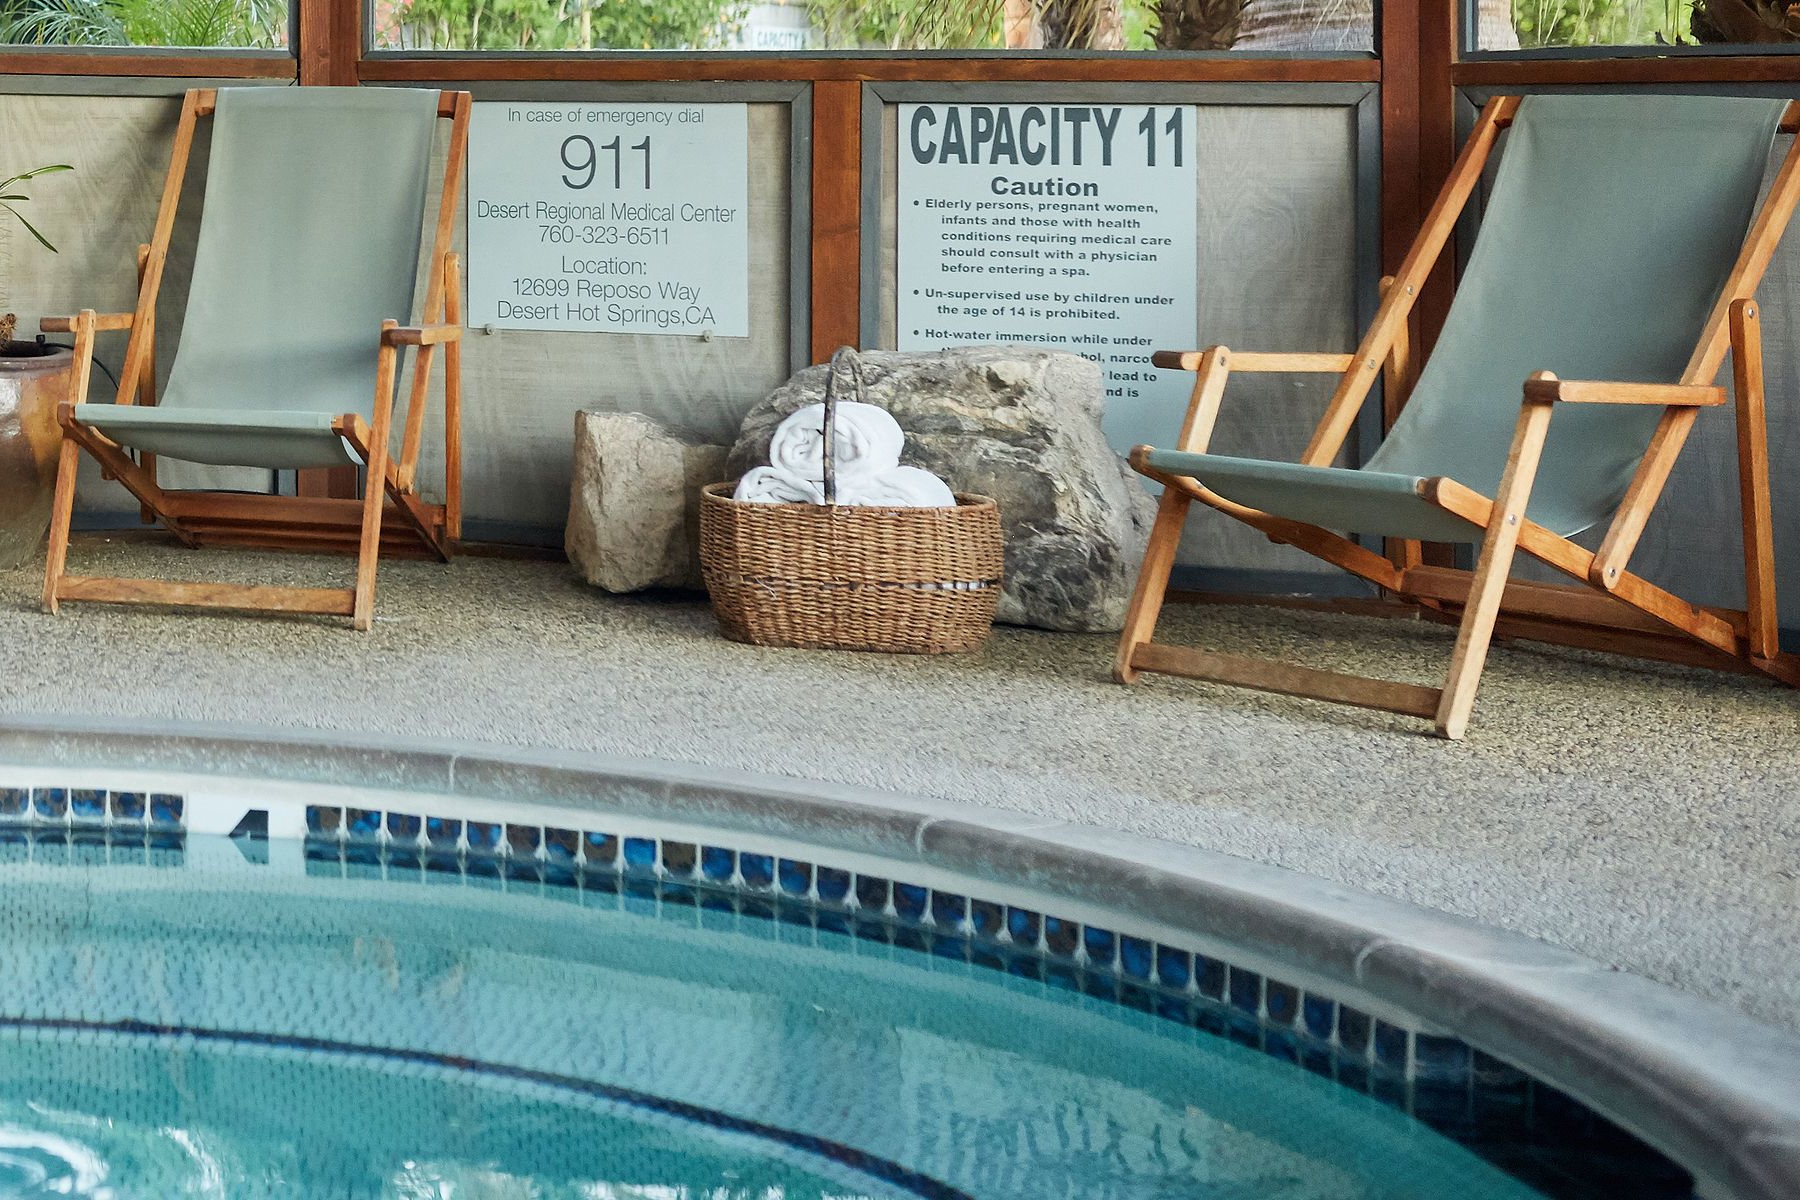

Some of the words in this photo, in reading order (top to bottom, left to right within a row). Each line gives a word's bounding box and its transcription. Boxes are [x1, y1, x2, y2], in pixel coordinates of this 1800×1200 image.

[508, 107, 521, 122] In
[526, 109, 563, 122] case
[567, 107, 582, 122] of
[586, 109, 673, 126] emergency
[677, 108, 705, 123] dial
[910, 105, 1123, 167] CAPACITY
[1138, 106, 1183, 168] 11
[560, 134, 651, 190] 911
[990, 175, 1099, 197] Caution
[477, 199, 530, 219] Desert
[535, 200, 605, 224] Regional
[611, 202, 675, 222] Medical
[680, 203, 737, 223] Center
[925, 198, 972, 212] Elderly
[975, 200, 1035, 213] persons,
[1038, 202, 1100, 214] pregnant
[1104, 203, 1160, 214] women,
[941, 214, 988, 226] infants
[991, 216, 1016, 226] and
[1020, 216, 1059, 227] those
[1063, 217, 1093, 228] with
[1097, 218, 1141, 229] health
[538, 224, 669, 245] 760-323-6511
[941, 231, 1012, 243] conditions
[1015, 232, 1077, 246] requiring
[1081, 234, 1136, 245] medical
[1140, 236, 1173, 246] care
[941, 247, 986, 258] should
[989, 248, 1040, 259] consult
[1043, 249, 1074, 260] with
[1078, 252, 1087, 260] a
[1091, 250, 1158, 263] physician
[562, 255, 647, 276] Location:
[941, 263, 985, 274] before
[988, 265, 1045, 277] entering
[1048, 266, 1057, 276] a
[1061, 267, 1090, 278] spa.
[512, 278, 570, 297] 12699
[577, 279, 652, 302] Reposo
[657, 281, 701, 305] Way
[925, 288, 1021, 302] Un-supervised
[1025, 291, 1050, 302] use
[1053, 291, 1071, 304] by
[1074, 293, 1130, 304] children
[1134, 295, 1175, 305] under
[497, 300, 559, 320] Desert
[567, 302, 601, 322] Hot
[607, 303, 716, 328] Springs,CA
[937, 304, 959, 315] the
[962, 306, 988, 317] age
[991, 306, 1005, 317] of
[1009, 306, 1026, 317] 14
[1030, 307, 1042, 317] is
[1045, 308, 1121, 320] prohibited.
[925, 328, 992, 340] Hot-water
[995, 330, 1067, 344] immersion
[1071, 333, 1109, 345] while
[1112, 335, 1153, 347] under
[1074, 351, 1105, 363] hol,
[1110, 354, 1151, 364] narco
[1109, 371, 1139, 381] lead
[1143, 373, 1157, 382] to
[1106, 387, 1123, 397] nd
[1127, 387, 1139, 398] is
